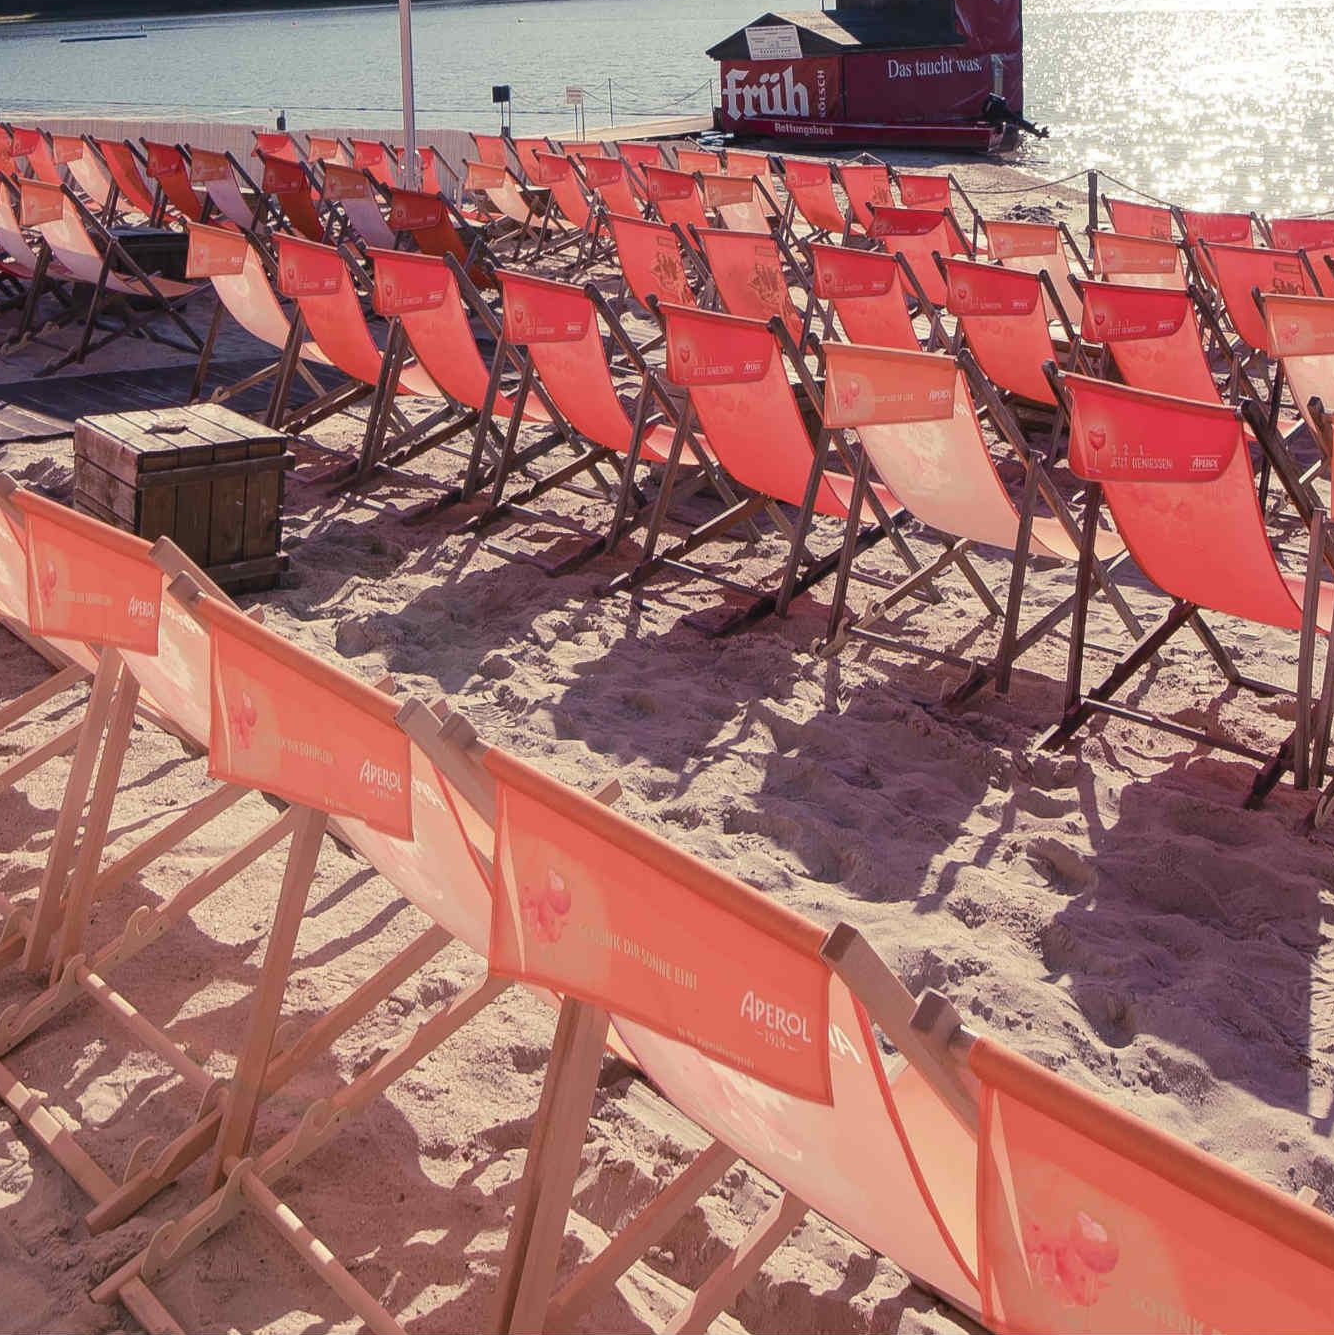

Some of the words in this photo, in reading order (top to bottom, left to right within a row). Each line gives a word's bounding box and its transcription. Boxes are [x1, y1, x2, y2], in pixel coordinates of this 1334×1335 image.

[887, 59, 913, 79] Das
[915, 54, 953, 77] taucht
[955, 57, 983, 73] was.
[722, 64, 810, 121] früh
[358, 757, 404, 794] APEROL
[738, 988, 813, 1045] APEROL
